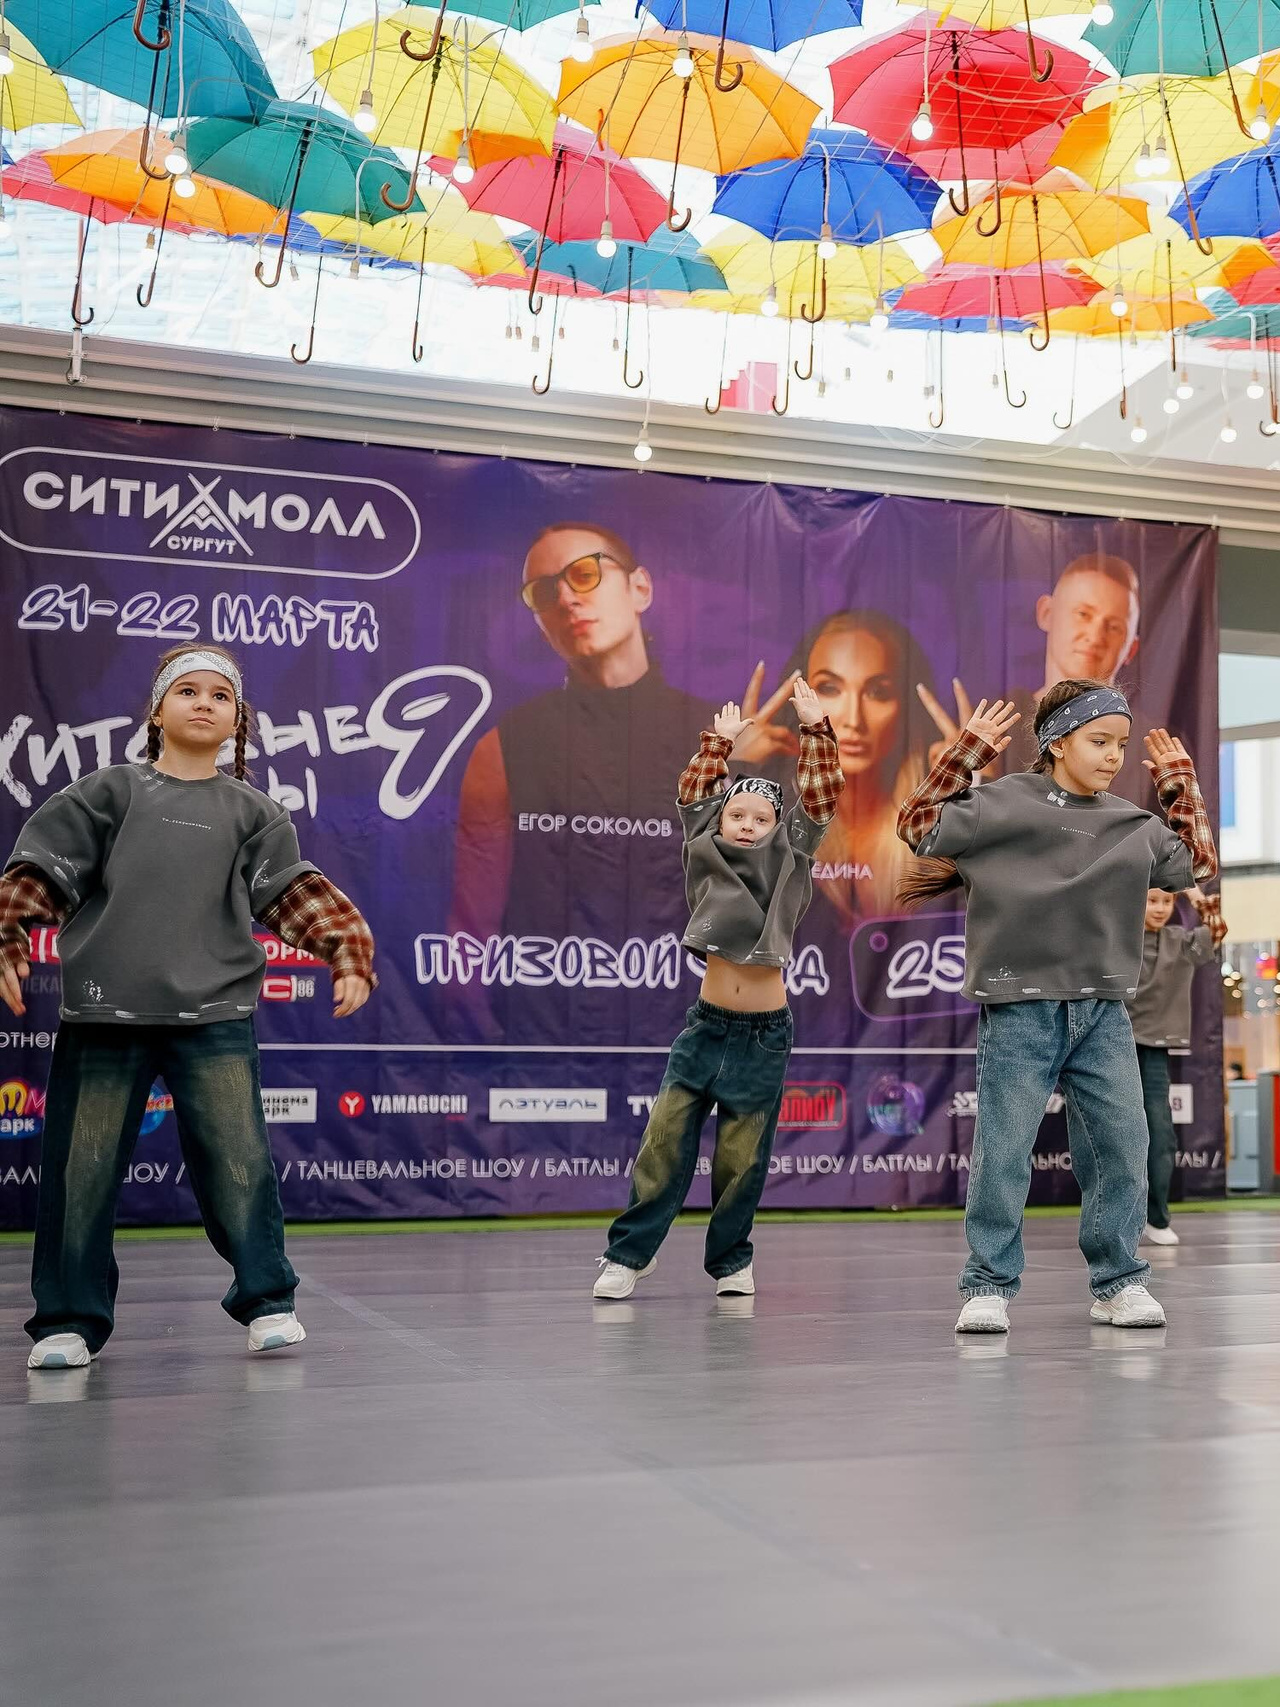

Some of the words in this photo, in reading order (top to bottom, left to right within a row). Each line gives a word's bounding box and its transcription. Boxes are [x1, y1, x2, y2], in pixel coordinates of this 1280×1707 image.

[23, 471, 180, 519] СИТИ
[228, 488, 386, 540] МОЛЛ
[167, 534, 237, 555] СУРГУТ
[17, 583, 200, 640] 21-22
[212, 592, 380, 653] МАРТА
[518, 812, 567, 832] ЕГОР
[571, 815, 673, 837] СОКОЛОВ
[811, 860, 874, 881] ЕДИНА
[414, 931, 681, 990] ПРИЗОВОЙ
[886, 935, 966, 999] 25
[371, 1094, 468, 1114] YAMAGUCHI
[1, 1118, 35, 1135] арк
[297, 1158, 467, 1181] ТАНЦЕВАЛЬНОЕ
[472, 1158, 525, 1178] ШОУ
[545, 1157, 620, 1178] БАТТЛЫ
[796, 1154, 845, 1174] ШОУ
[862, 1153, 933, 1174] БАТТЛЫ
